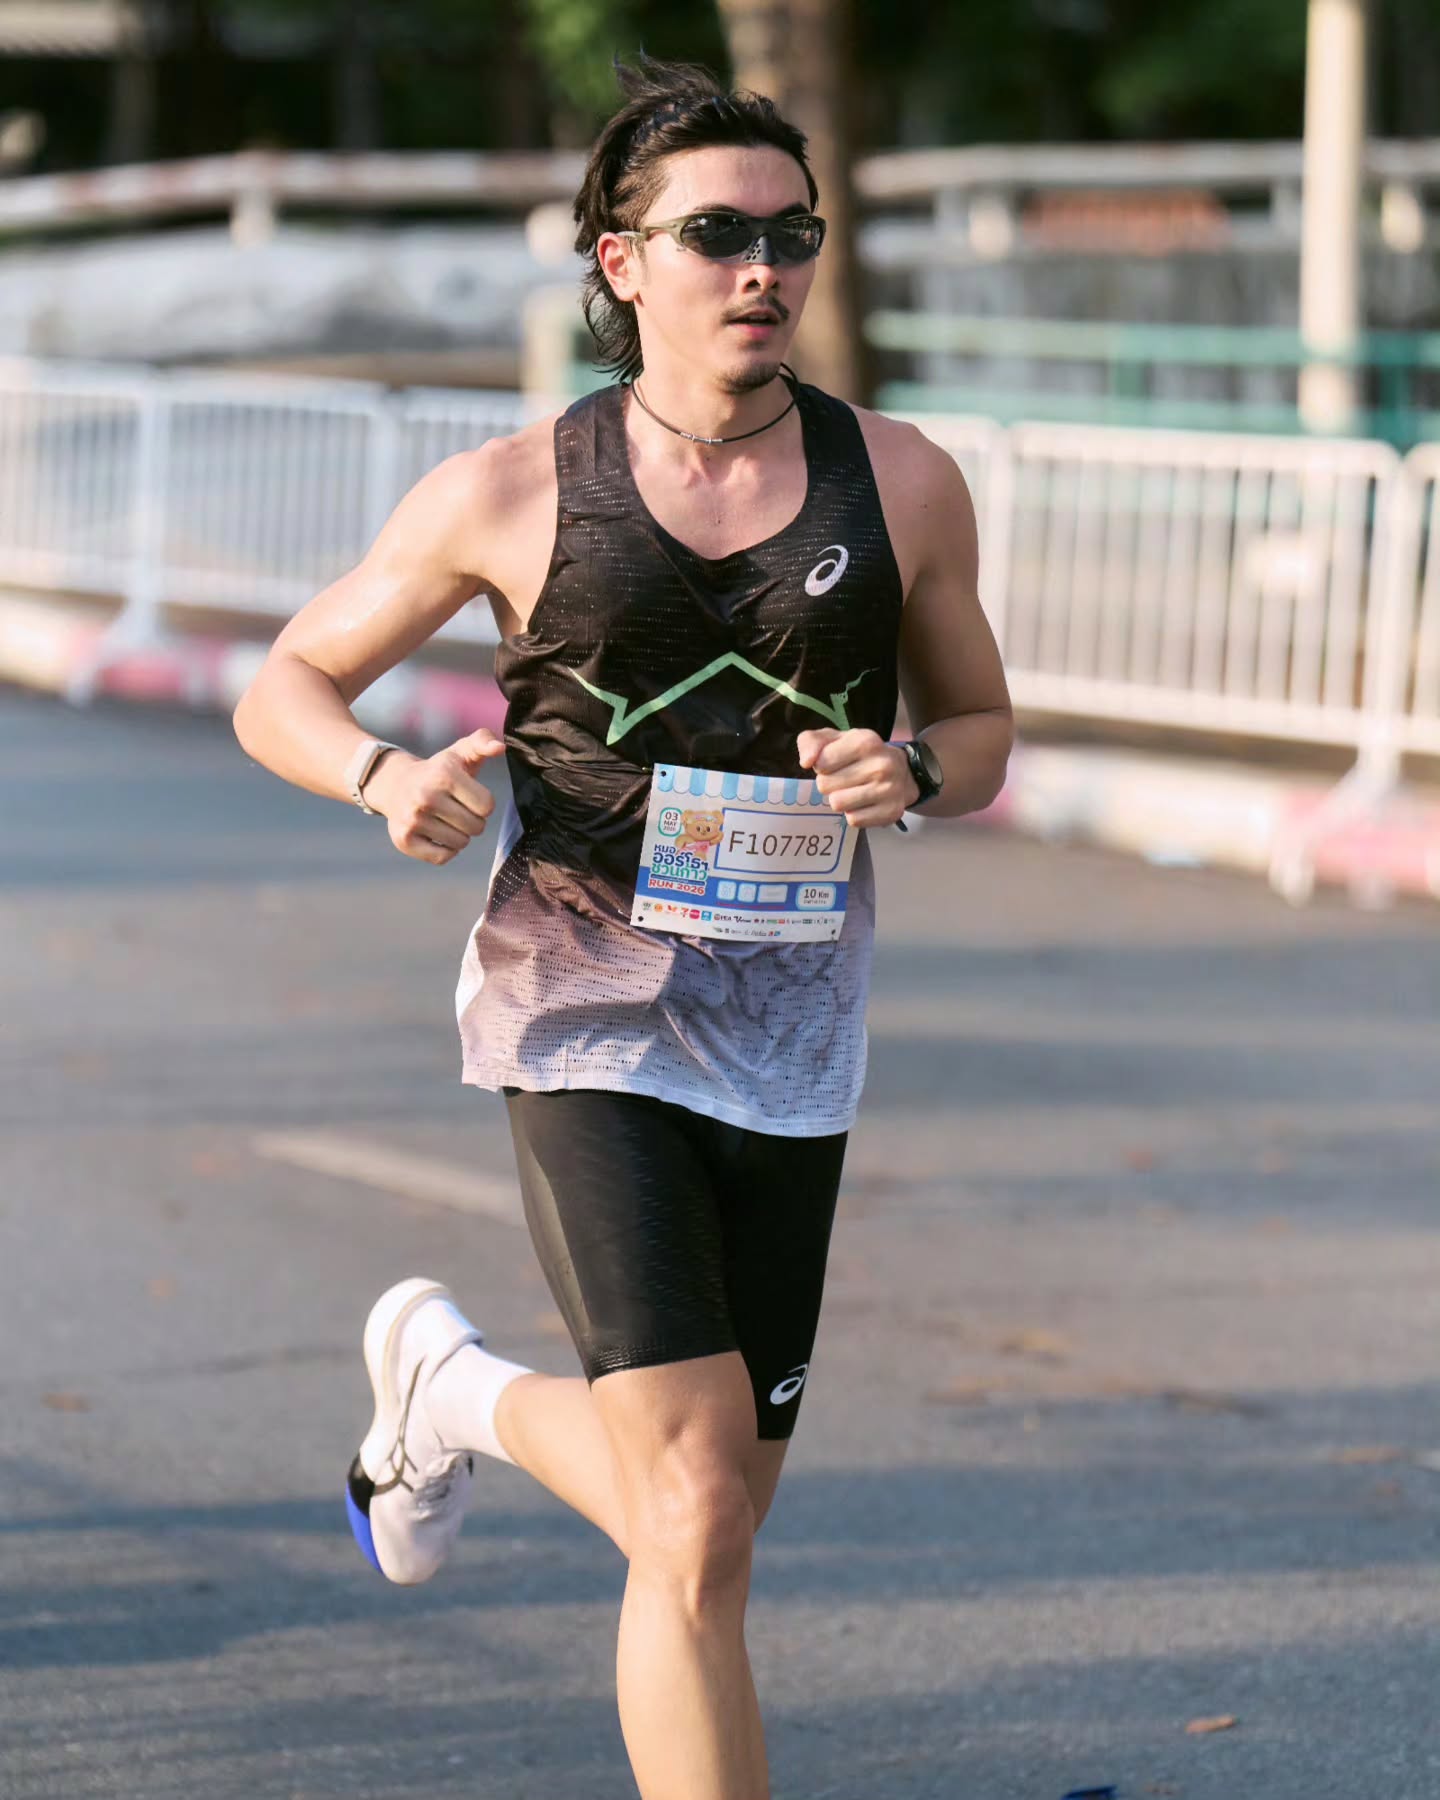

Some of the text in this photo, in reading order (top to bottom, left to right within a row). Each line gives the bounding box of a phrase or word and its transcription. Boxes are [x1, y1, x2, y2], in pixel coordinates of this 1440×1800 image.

[665, 811, 679, 821] 03
[654, 843, 677, 854] หมอ
[729, 830, 833, 857] F107782
[651, 862, 708, 881] ชวนก้าว
[649, 879, 674, 889] RUN
[676, 882, 705, 895] 2026
[804, 888, 830, 899] 10 Km
